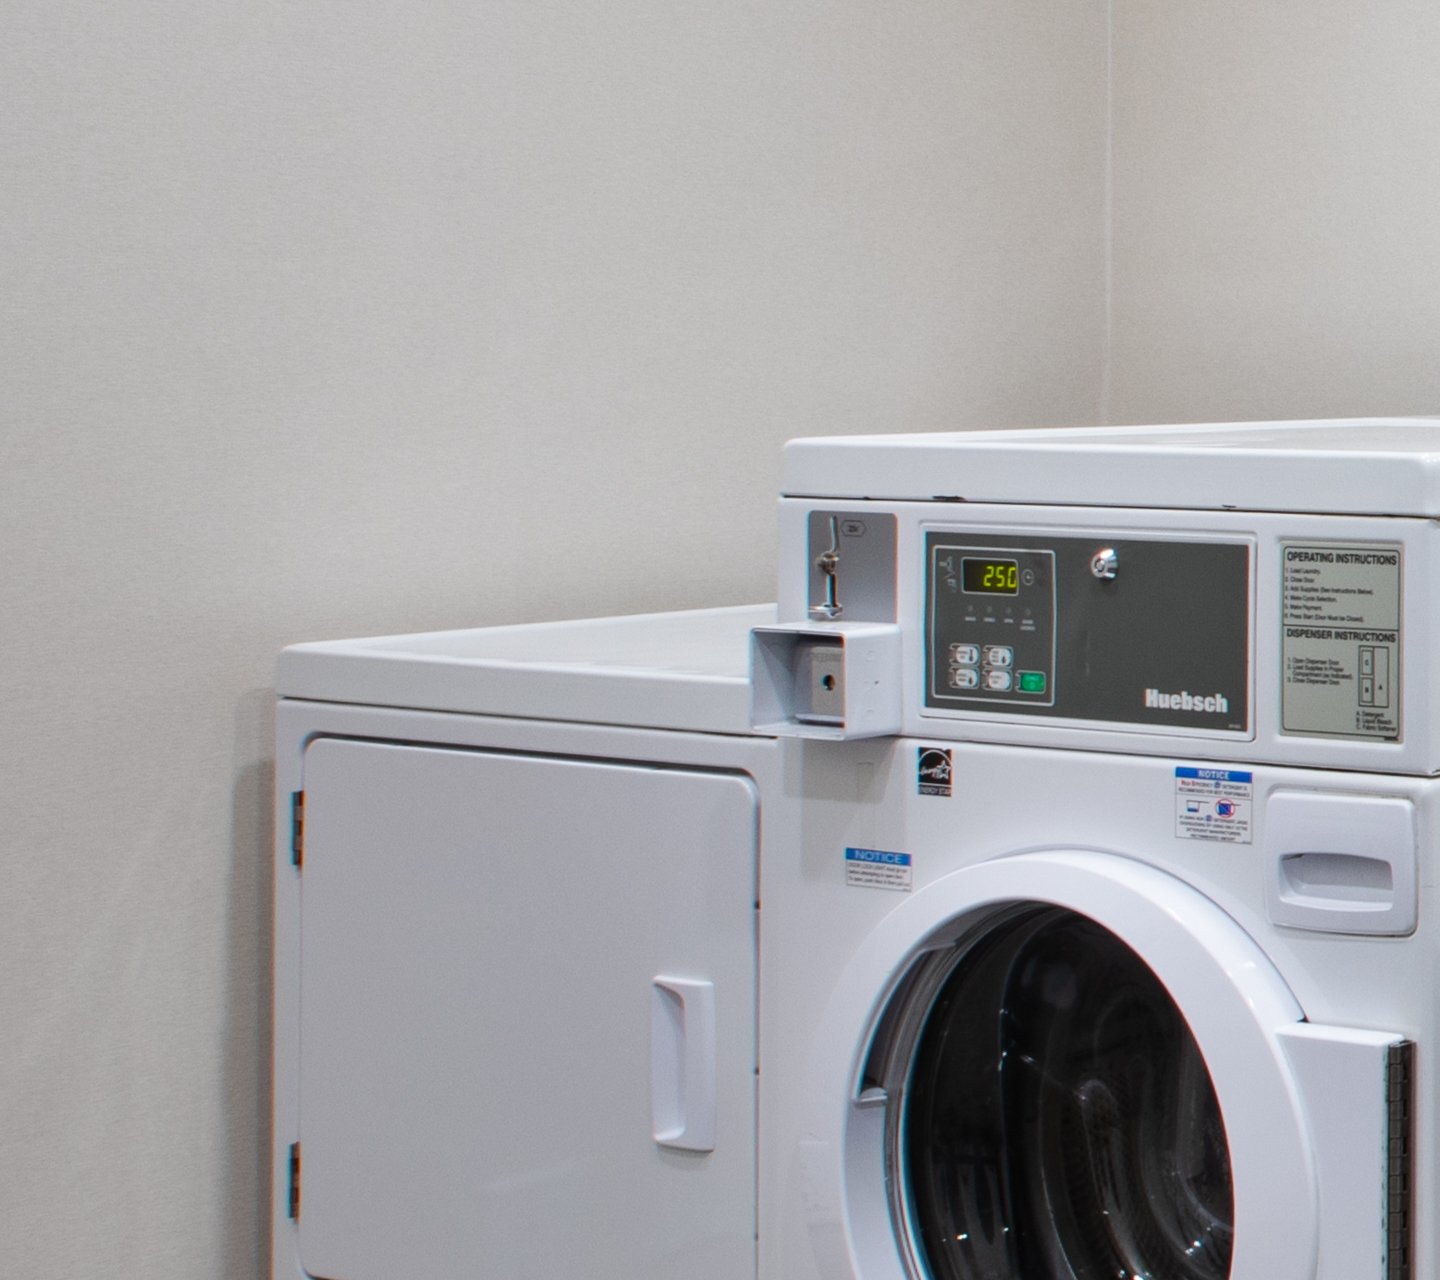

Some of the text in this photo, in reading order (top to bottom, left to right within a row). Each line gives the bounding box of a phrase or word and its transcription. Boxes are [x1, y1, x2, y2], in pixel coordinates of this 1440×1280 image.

[1287, 551, 1397, 565] OPERATING INSTRUCTIONS
[1145, 688, 1228, 713] Huebsch
[1199, 769, 1230, 780] NOTICE
